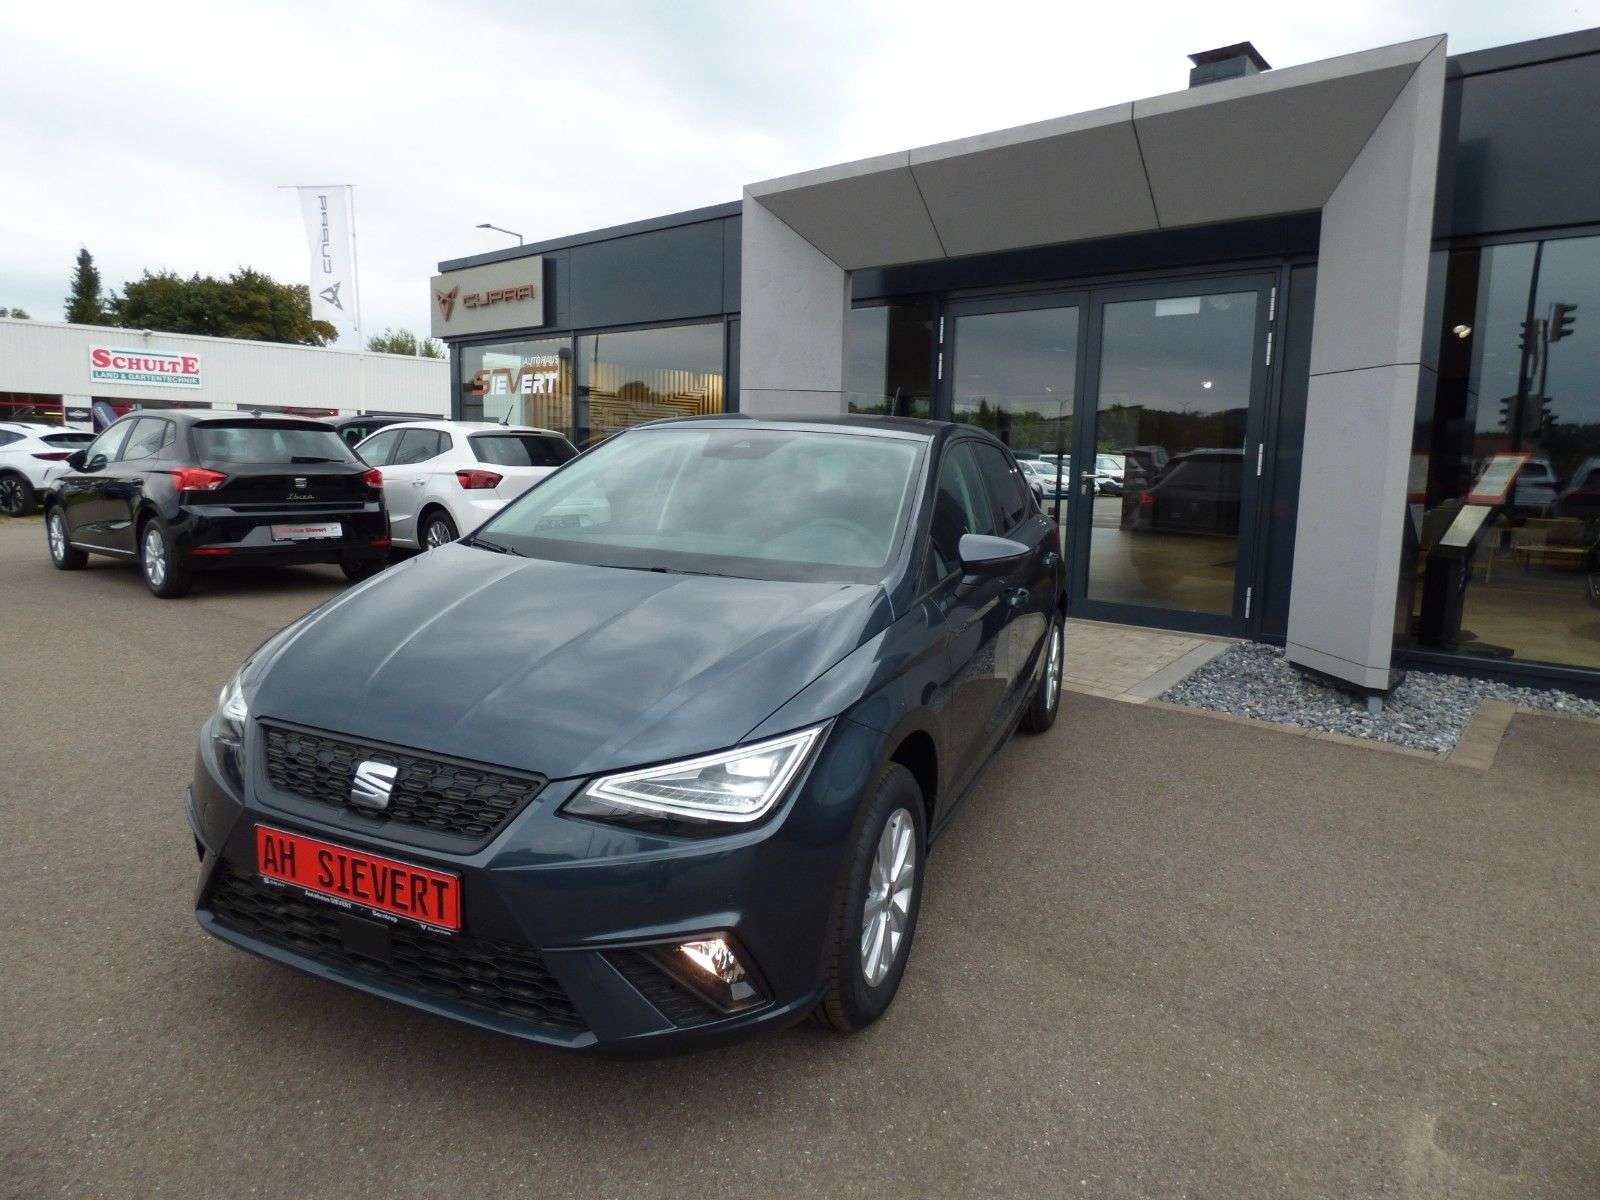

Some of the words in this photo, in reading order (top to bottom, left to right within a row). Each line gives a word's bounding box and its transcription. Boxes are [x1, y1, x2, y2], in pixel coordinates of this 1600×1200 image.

[463, 285, 535, 308] CUPRA
[92, 348, 199, 375] SCHULTE
[95, 371, 119, 379] LAND
[128, 373, 200, 384] GARTENTECHNIK
[472, 366, 559, 396] SIEVERT
[262, 834, 296, 879] AH
[317, 850, 449, 919] SIEVERT
